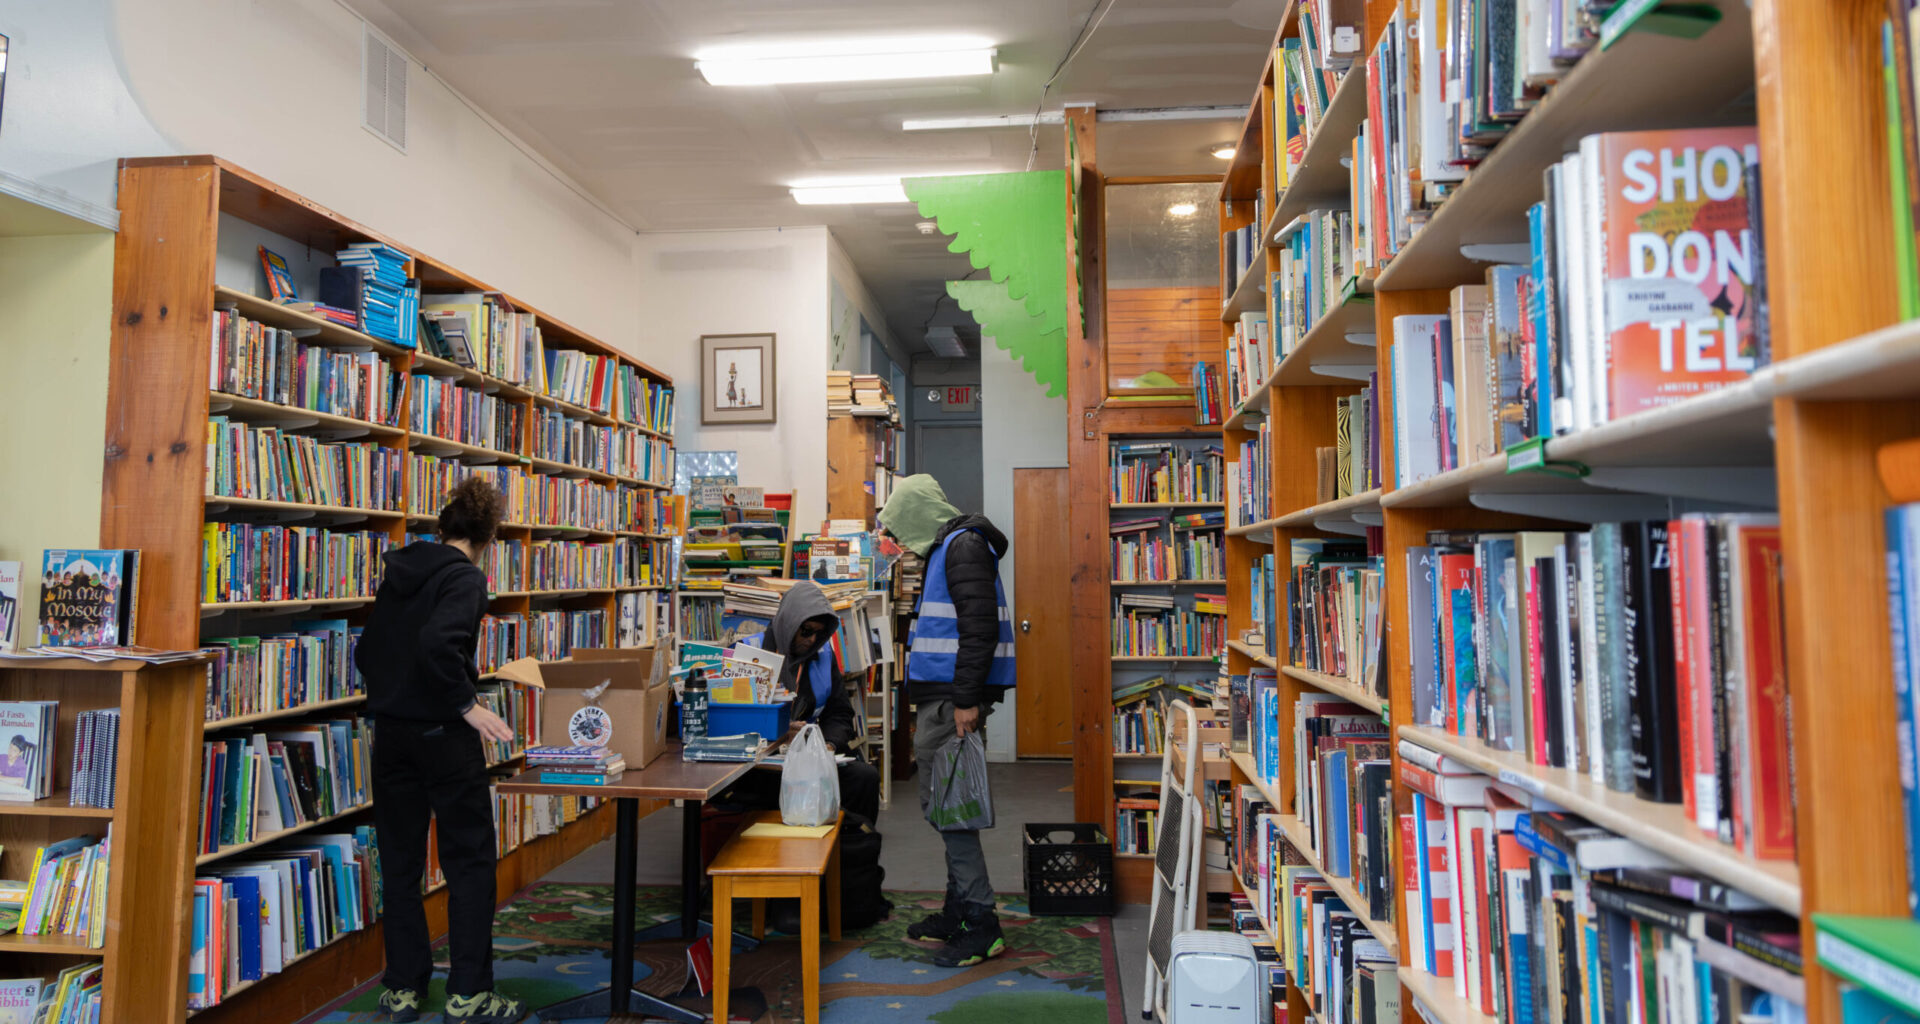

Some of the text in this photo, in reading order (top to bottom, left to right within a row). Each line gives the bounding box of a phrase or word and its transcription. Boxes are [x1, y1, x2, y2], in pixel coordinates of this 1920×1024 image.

[1628, 292, 1666, 301] KRISTINE
[948, 387, 971, 405] EXIT
[1521, 398, 1530, 427] Rain
[1671, 532, 1680, 604] HOWARD
[57, 586, 104, 604] In My
[1594, 562, 1607, 645] SONDHEIM
[47, 602, 112, 622] Mosque
[1483, 602, 1491, 665] MALAMUD
[1673, 605, 1684, 663] STERN
[1623, 607, 1639, 697] Barbra
[1, 719, 35, 728] Ramadan
